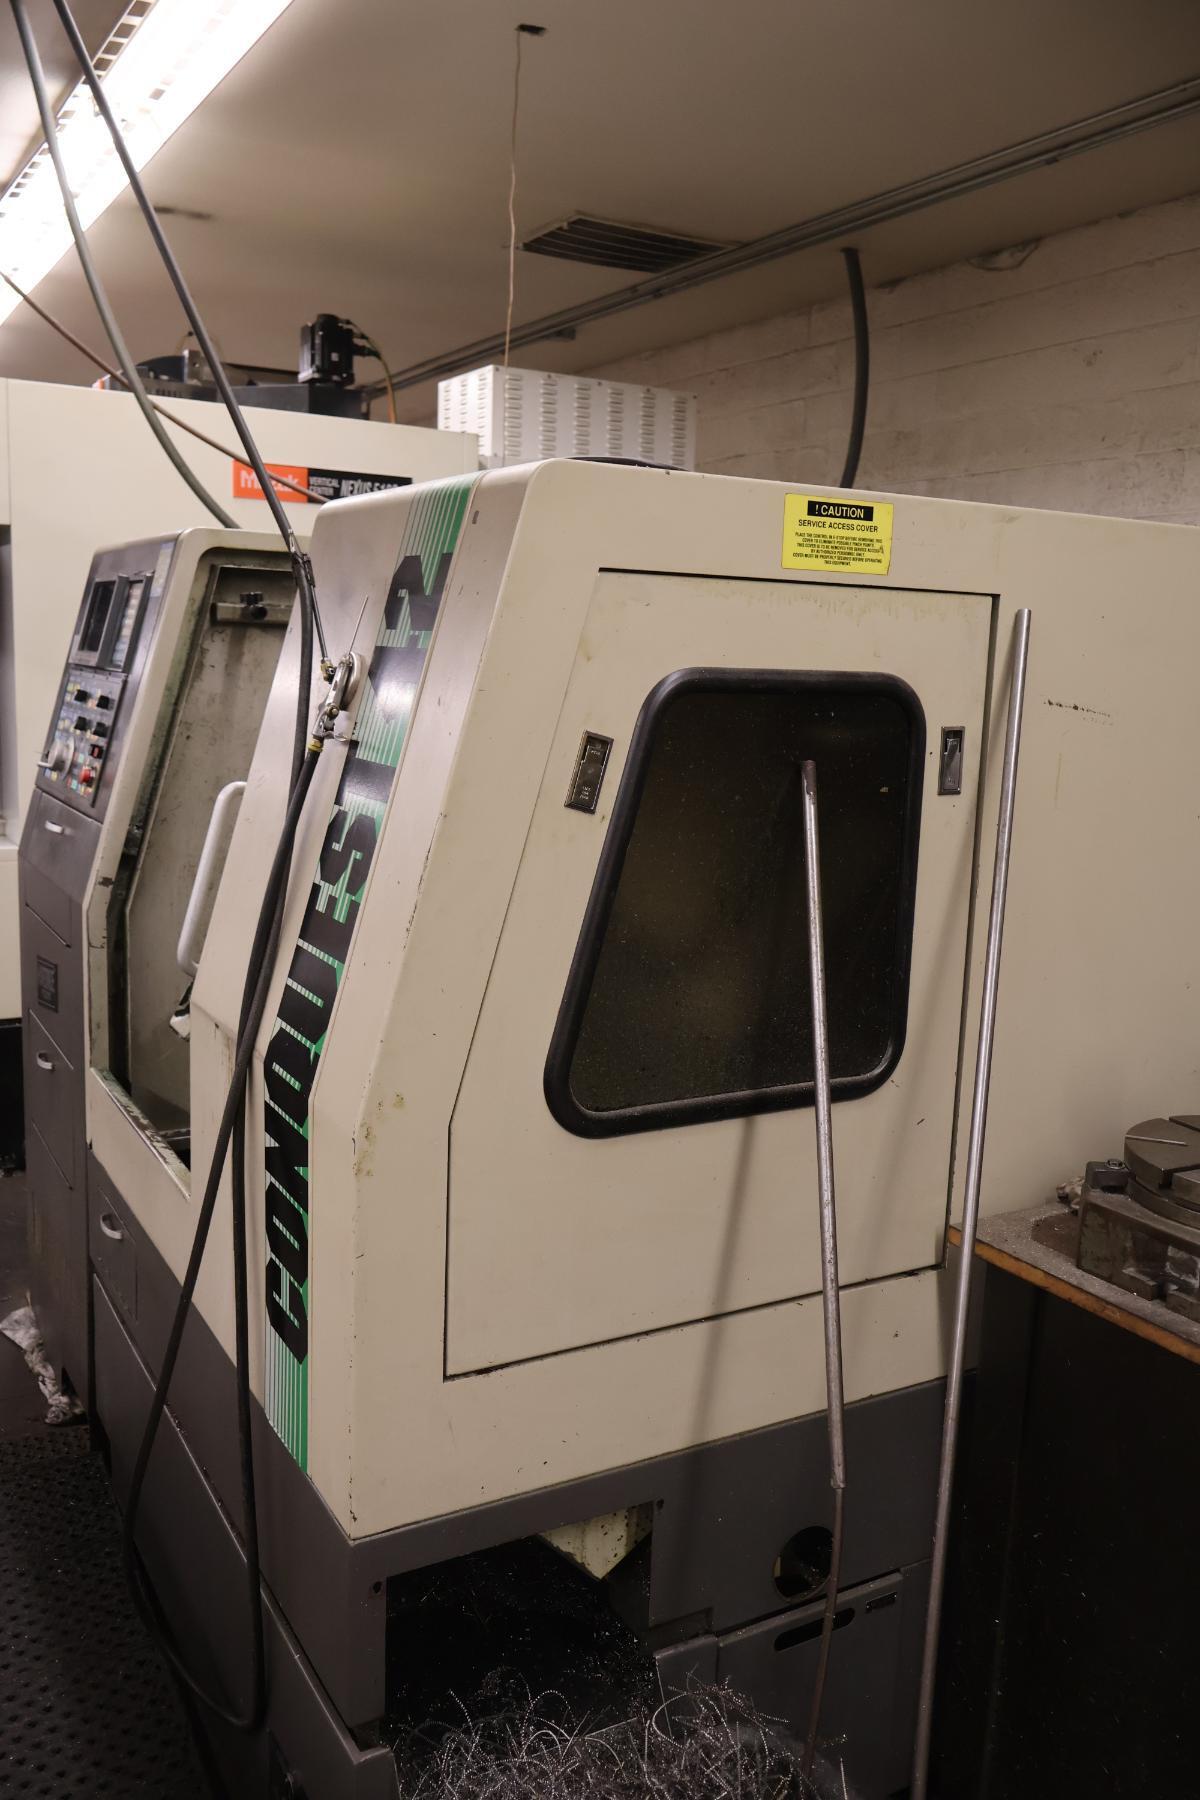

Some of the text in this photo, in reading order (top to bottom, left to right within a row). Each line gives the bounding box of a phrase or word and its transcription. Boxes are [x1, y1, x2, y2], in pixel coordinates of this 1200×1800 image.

[309, 476, 339, 488] VERTICAL
[340, 479, 372, 496] NEXUS
[821, 505, 864, 519] CAUTION
[799, 519, 878, 533] SERVICE ACCESS COVER
[264, 552, 453, 1365] CONQUEST 42
